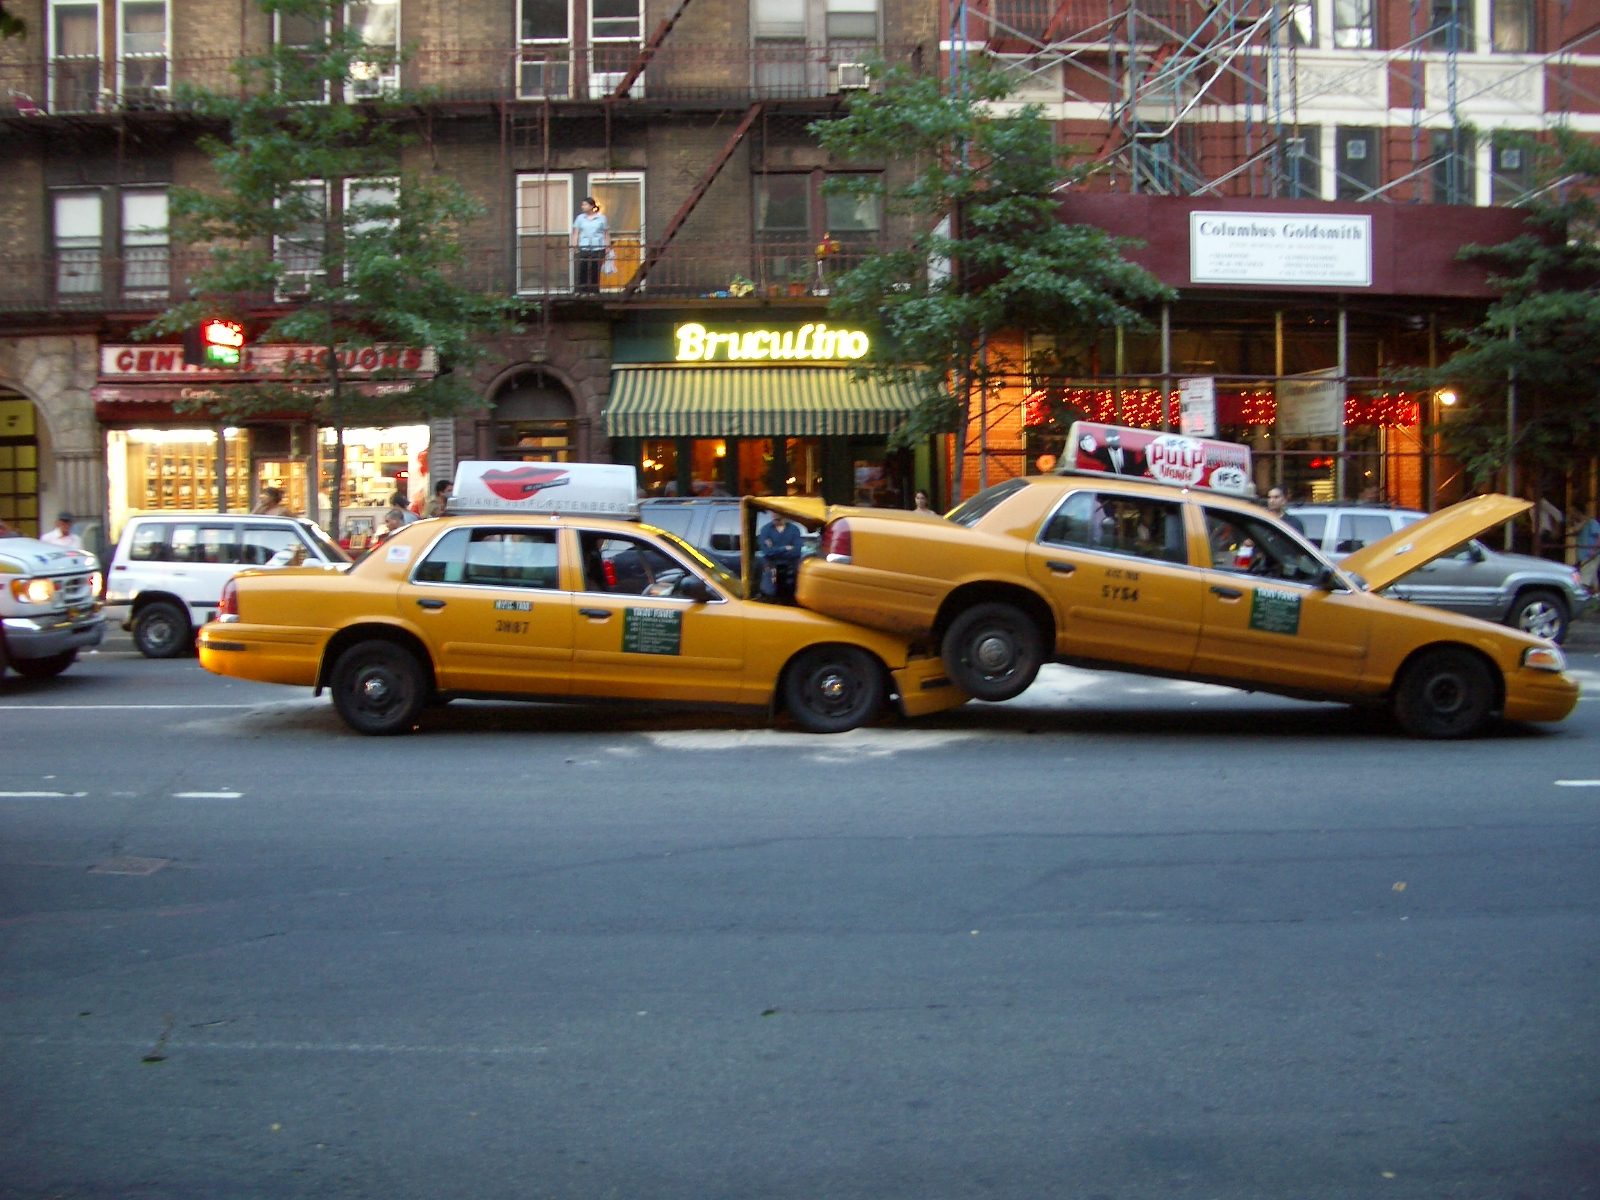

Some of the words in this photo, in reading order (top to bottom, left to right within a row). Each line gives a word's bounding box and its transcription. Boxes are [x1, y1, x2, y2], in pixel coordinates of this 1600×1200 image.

[1200, 220, 1276, 238] Columbus
[1282, 223, 1362, 240] Goldsmith
[675, 322, 870, 361] Bruculino
[116, 349, 256, 372] CENL
[1152, 443, 1207, 468] PULP
[1216, 473, 1241, 485] IFC
